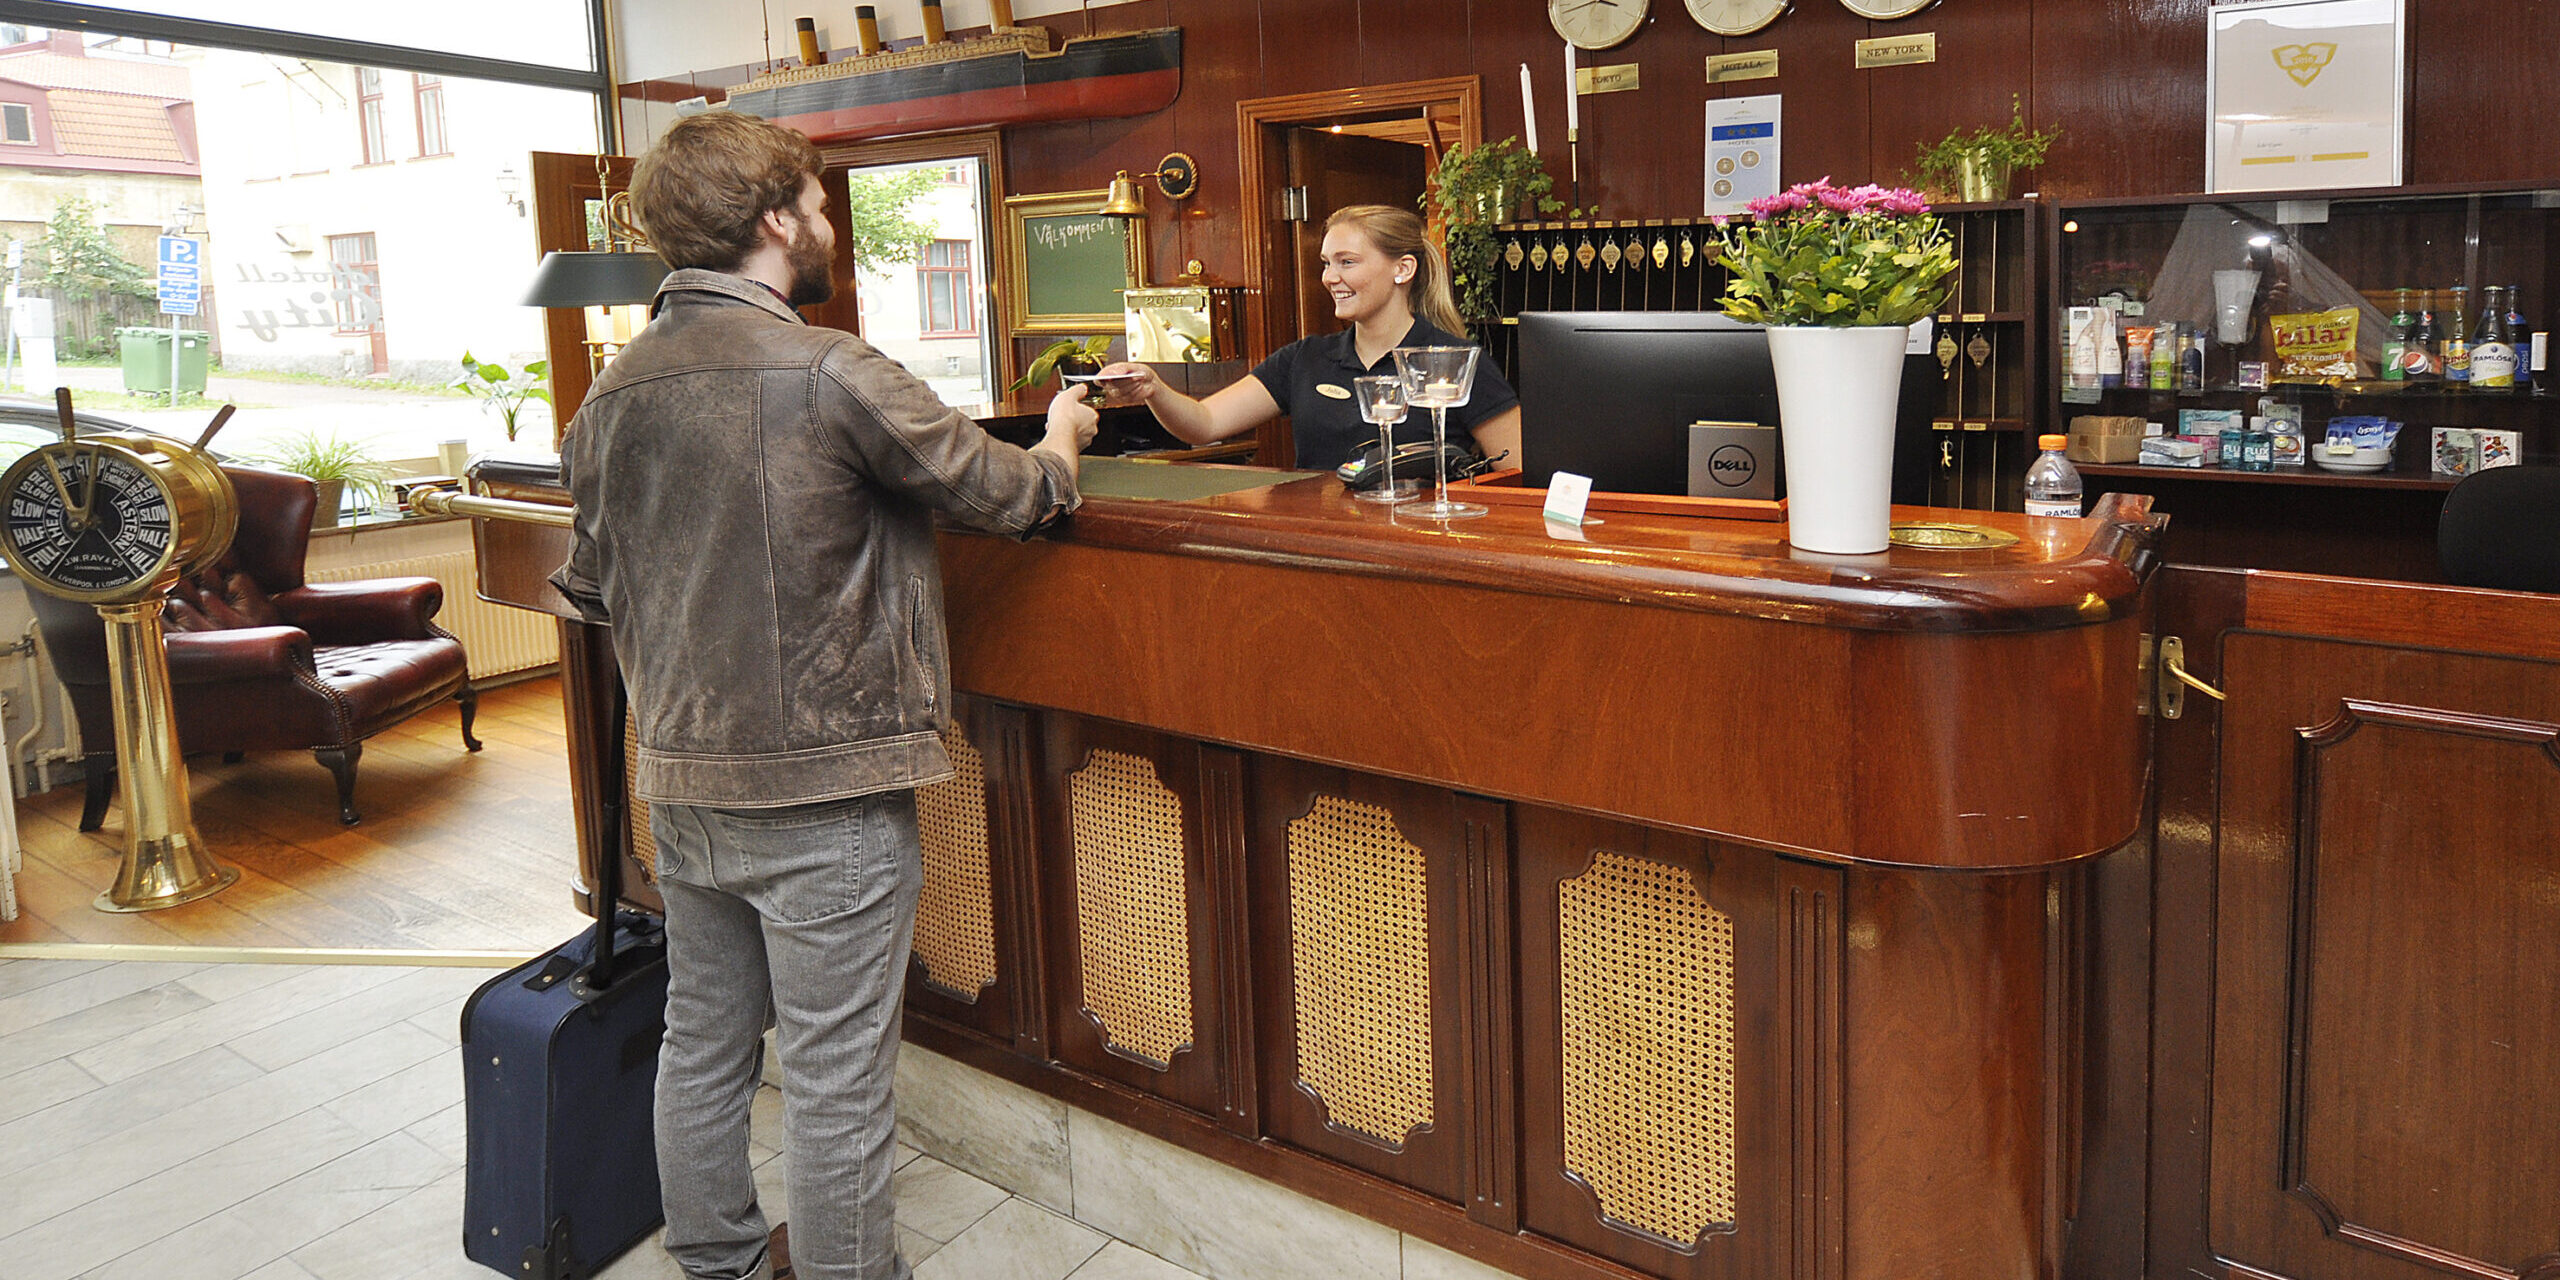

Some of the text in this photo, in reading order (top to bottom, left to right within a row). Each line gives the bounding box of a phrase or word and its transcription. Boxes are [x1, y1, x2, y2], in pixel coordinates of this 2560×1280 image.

[1866, 44, 1924, 58] NEW YORK
[1720, 61, 1763, 72] MOTALA
[1591, 74, 1622, 85] TOKYO
[170, 240, 191, 261] P
[1145, 296, 1186, 308] POST
[2277, 324, 2351, 348] bilar
[2223, 444, 2241, 452] FLU
[2245, 446, 2270, 455] FLUX
[75, 455, 106, 479] STP
[1714, 460, 1751, 471] DELL
[20, 480, 50, 501] SLOW
[28, 469, 56, 494] DEAD
[11, 498, 44, 519] SLOW
[140, 504, 170, 523] SLOW
[46, 496, 71, 548] AHEAD
[116, 500, 138, 551] ASTERN
[12, 526, 46, 547] HALF
[138, 528, 170, 549] HALF
[26, 544, 61, 572] FULL
[82, 554, 105, 562] RAY
[124, 545, 158, 574] FULL
[57, 573, 93, 588] LIVERPOOL
[101, 575, 129, 588] LONDON
